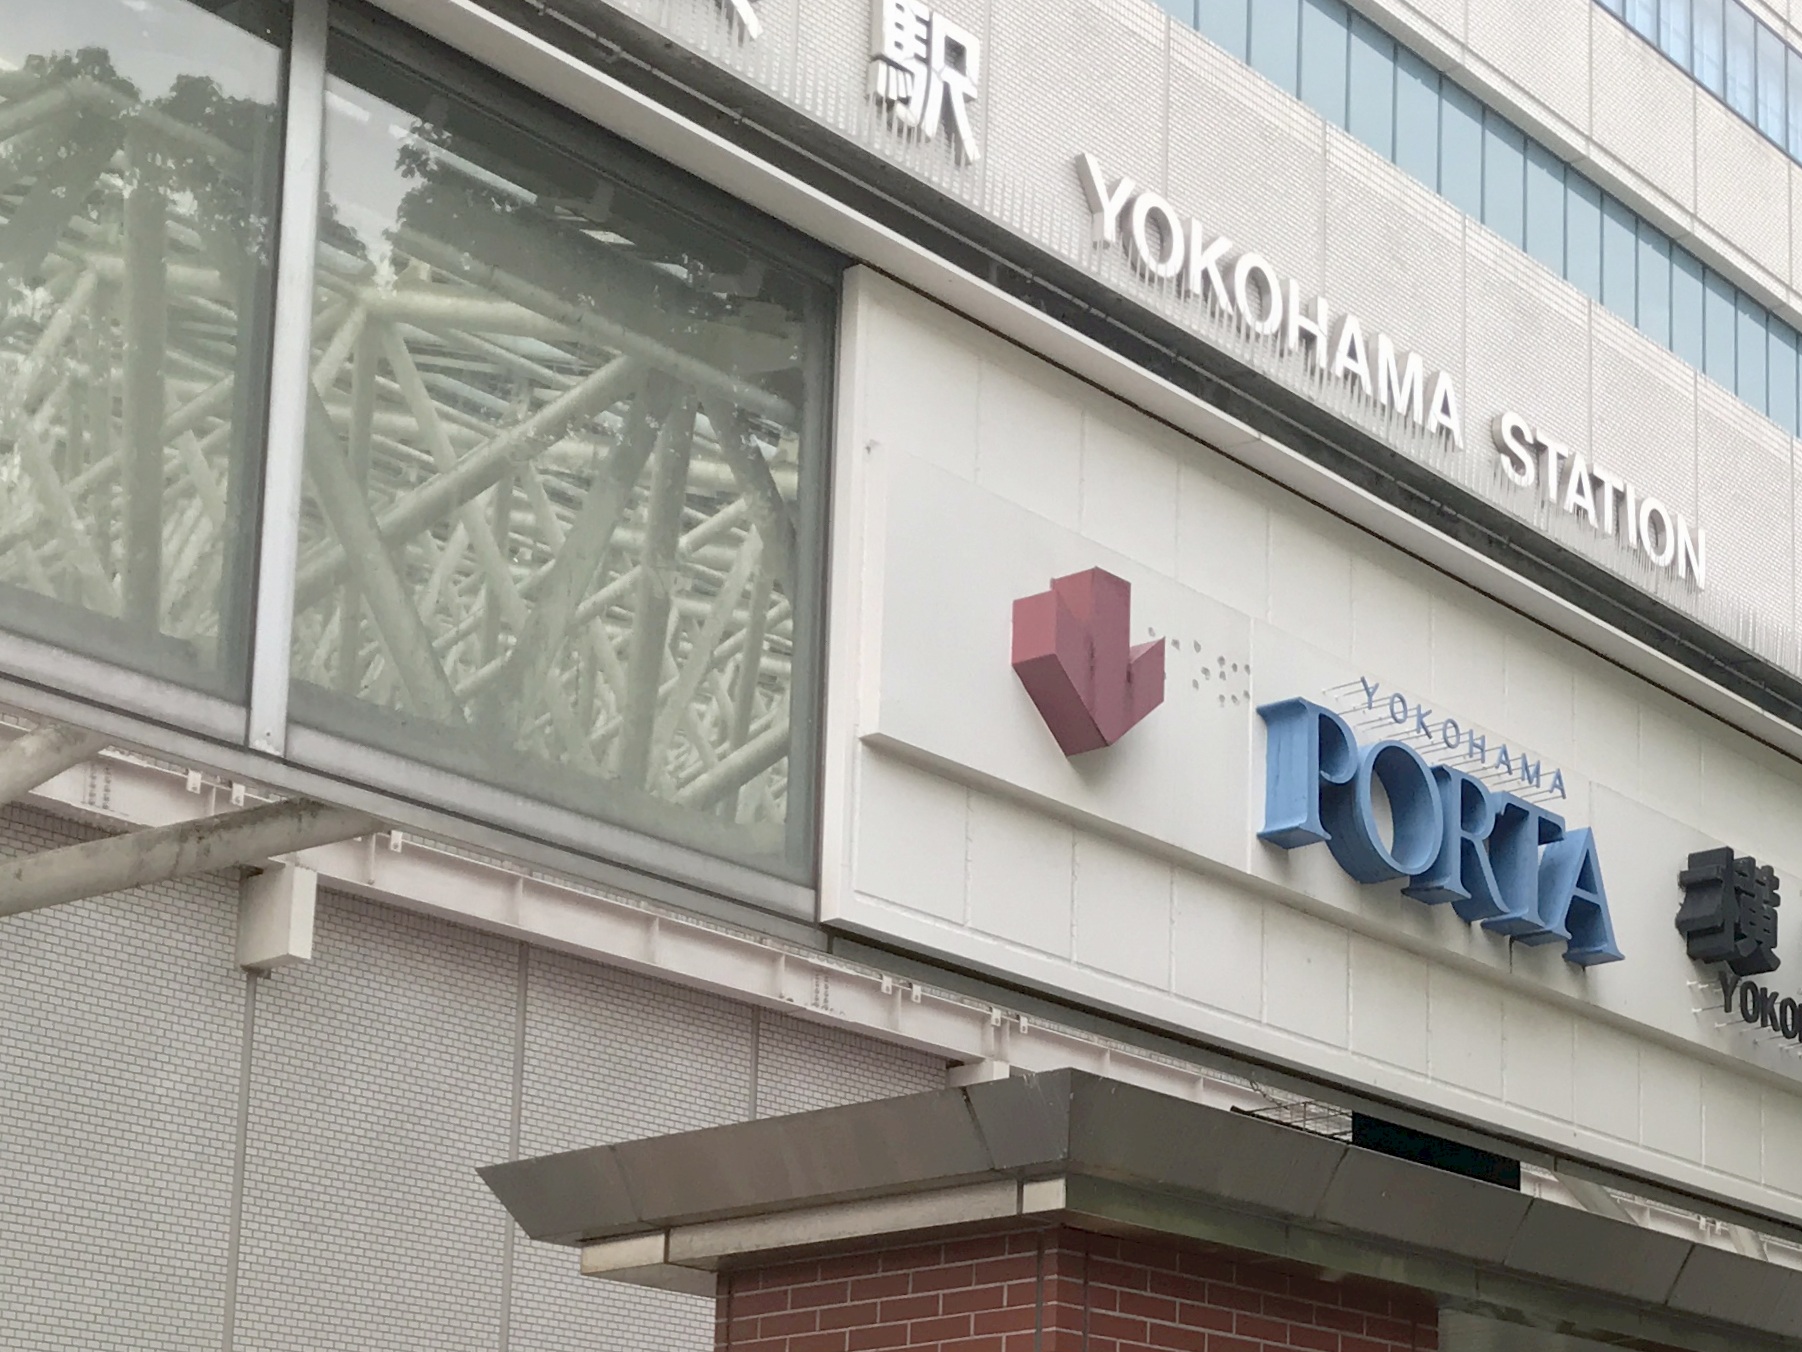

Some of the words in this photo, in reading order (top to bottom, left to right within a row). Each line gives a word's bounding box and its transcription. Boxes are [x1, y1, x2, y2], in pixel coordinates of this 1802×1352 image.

[1076, 152, 1464, 451] YOKOHAMA
[1492, 410, 1706, 592] STATION
[1256, 696, 1625, 967] PORTA
[1360, 675, 1567, 800] YOKOHAMA
